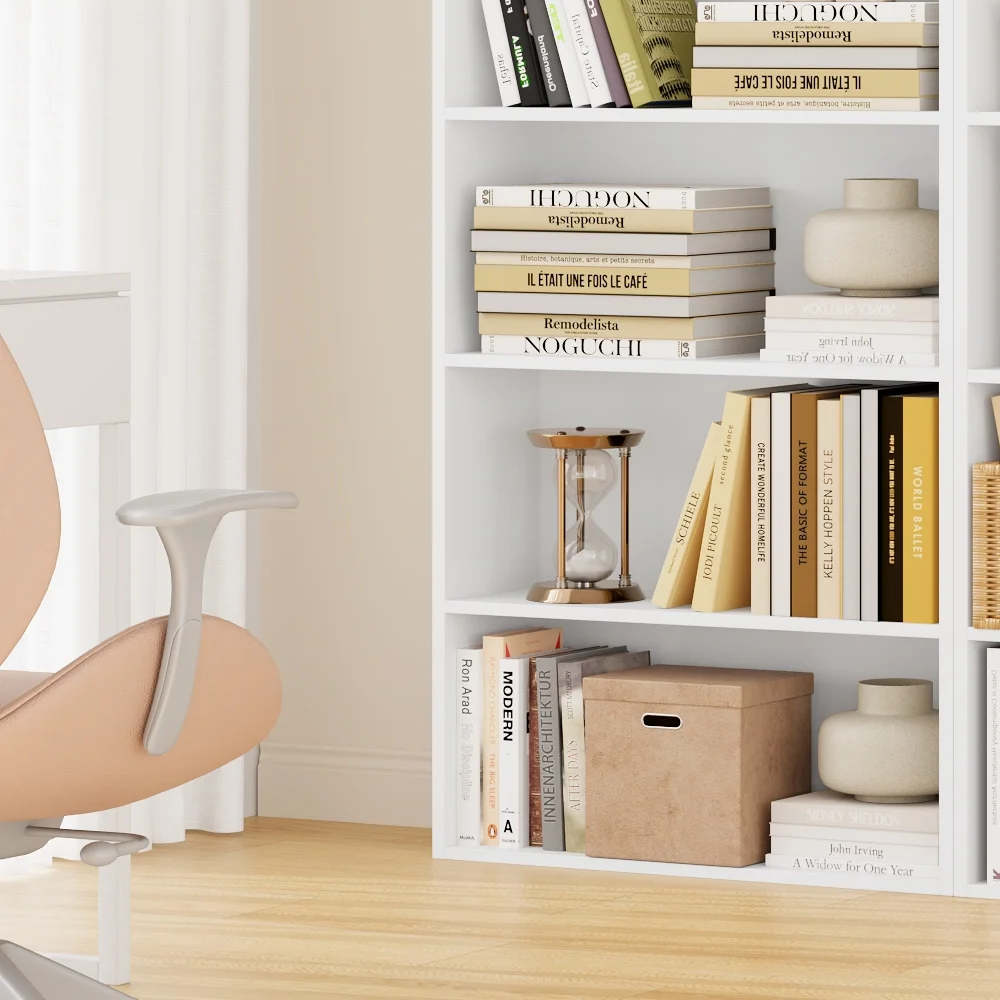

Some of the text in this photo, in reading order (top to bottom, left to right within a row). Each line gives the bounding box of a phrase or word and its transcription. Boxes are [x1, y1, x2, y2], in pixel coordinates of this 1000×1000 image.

[753, 4, 878, 22] NOGUCHI
[772, 29, 852, 42] Remodelista
[529, 189, 650, 209] NOGUCHI
[548, 215, 625, 228] Remodelista
[520, 255, 549, 264] Histoire,
[550, 255, 584, 265] botanique,
[610, 257, 629, 265] petits
[630, 257, 655, 265] secrets
[527, 271, 648, 289] IL ÉTAIT UNE FOIS LE CAFÉ
[544, 318, 619, 332] Remodelista
[524, 336, 642, 357] NOGUCHI
[720, 424, 734, 485] second glance
[758, 442, 766, 562] CREATE WONDERFUL HOMELIFE
[799, 440, 808, 566] THE BASIC OF FORMAT
[913, 466, 923, 559] WORLD BALLET
[676, 491, 701, 546] SCHIELE
[824, 450, 833, 579] KELLY HOPPEN STYLE
[703, 504, 722, 581] JODI PICOULT
[503, 671, 514, 742] MODERN
[537, 670, 556, 823] INNENARCHITEKTUR
[566, 740, 581, 811] AFTER DAYS
[504, 820, 513, 834] A
[829, 844, 884, 859] John Irving
[793, 859, 914, 876] A Widow for One Year
